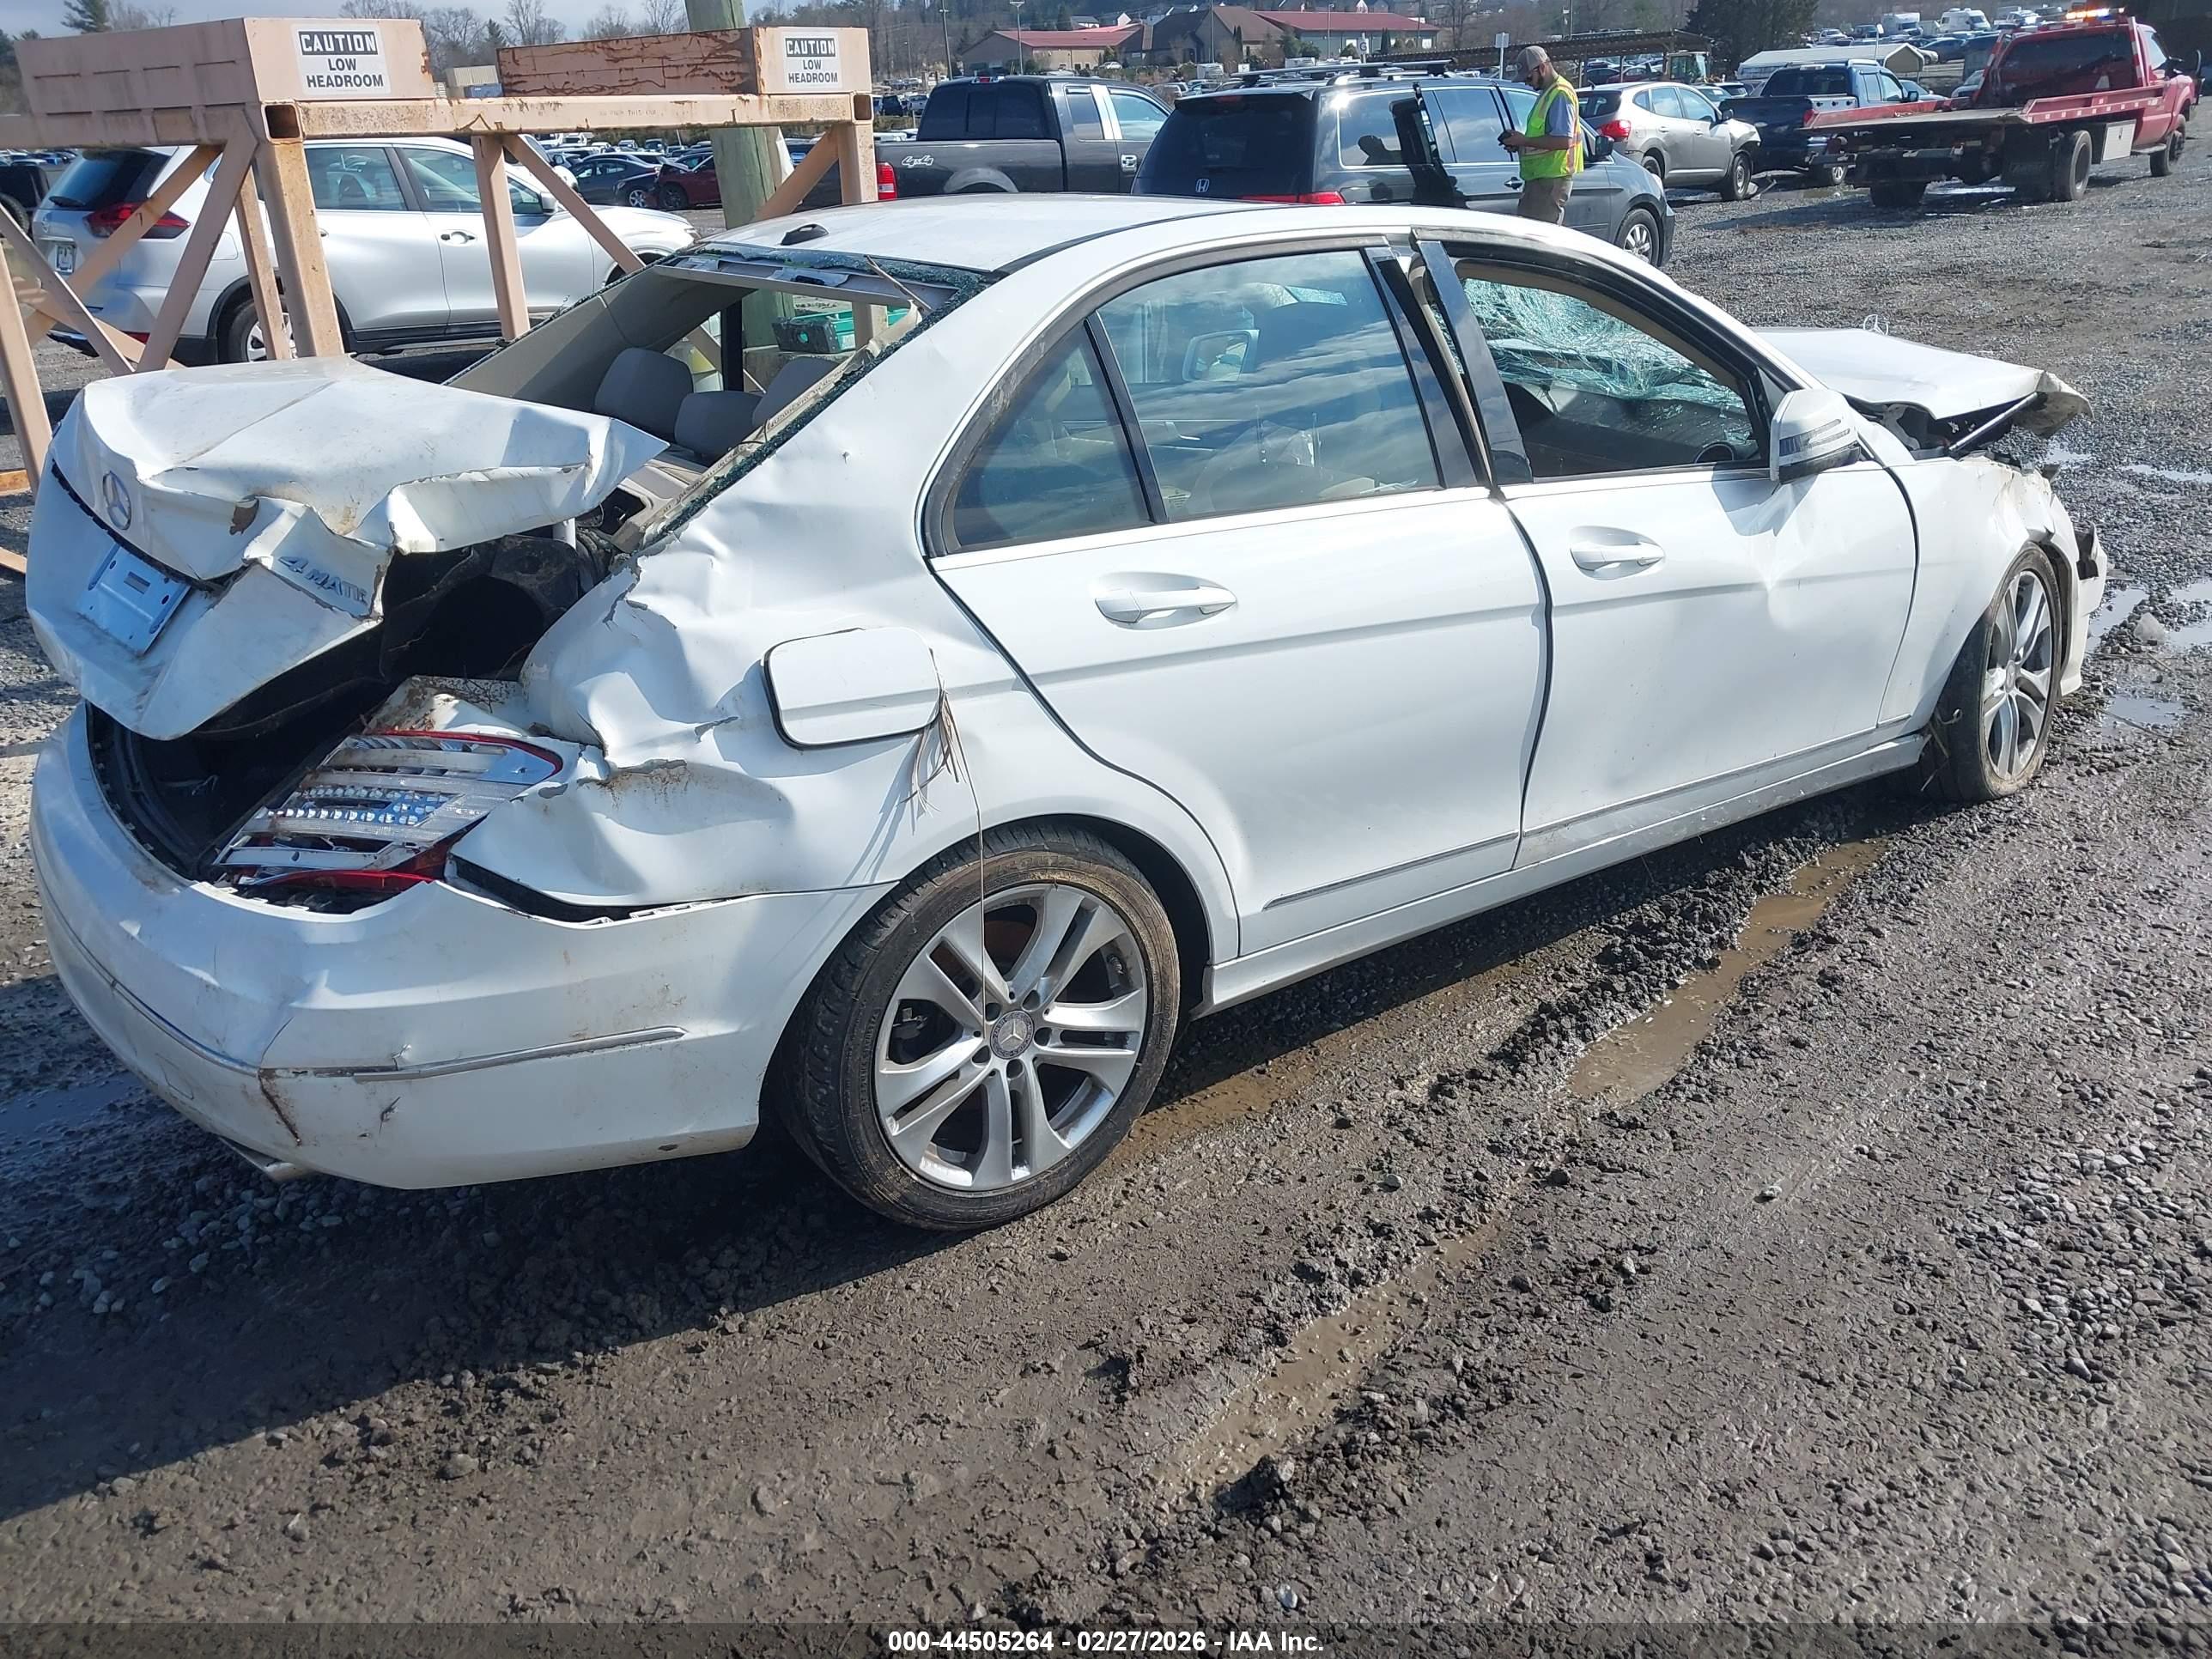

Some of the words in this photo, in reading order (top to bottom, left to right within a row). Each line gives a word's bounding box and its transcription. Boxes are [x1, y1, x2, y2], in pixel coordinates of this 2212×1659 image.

[301, 33, 377, 52] CAUTION
[786, 40, 836, 55] CAUTION
[327, 58, 357, 71] LOW
[802, 59, 822, 70] LOW
[306, 74, 385, 88] HEADROOM
[787, 72, 839, 83] HEADROOM
[902, 155, 934, 167] 4x4
